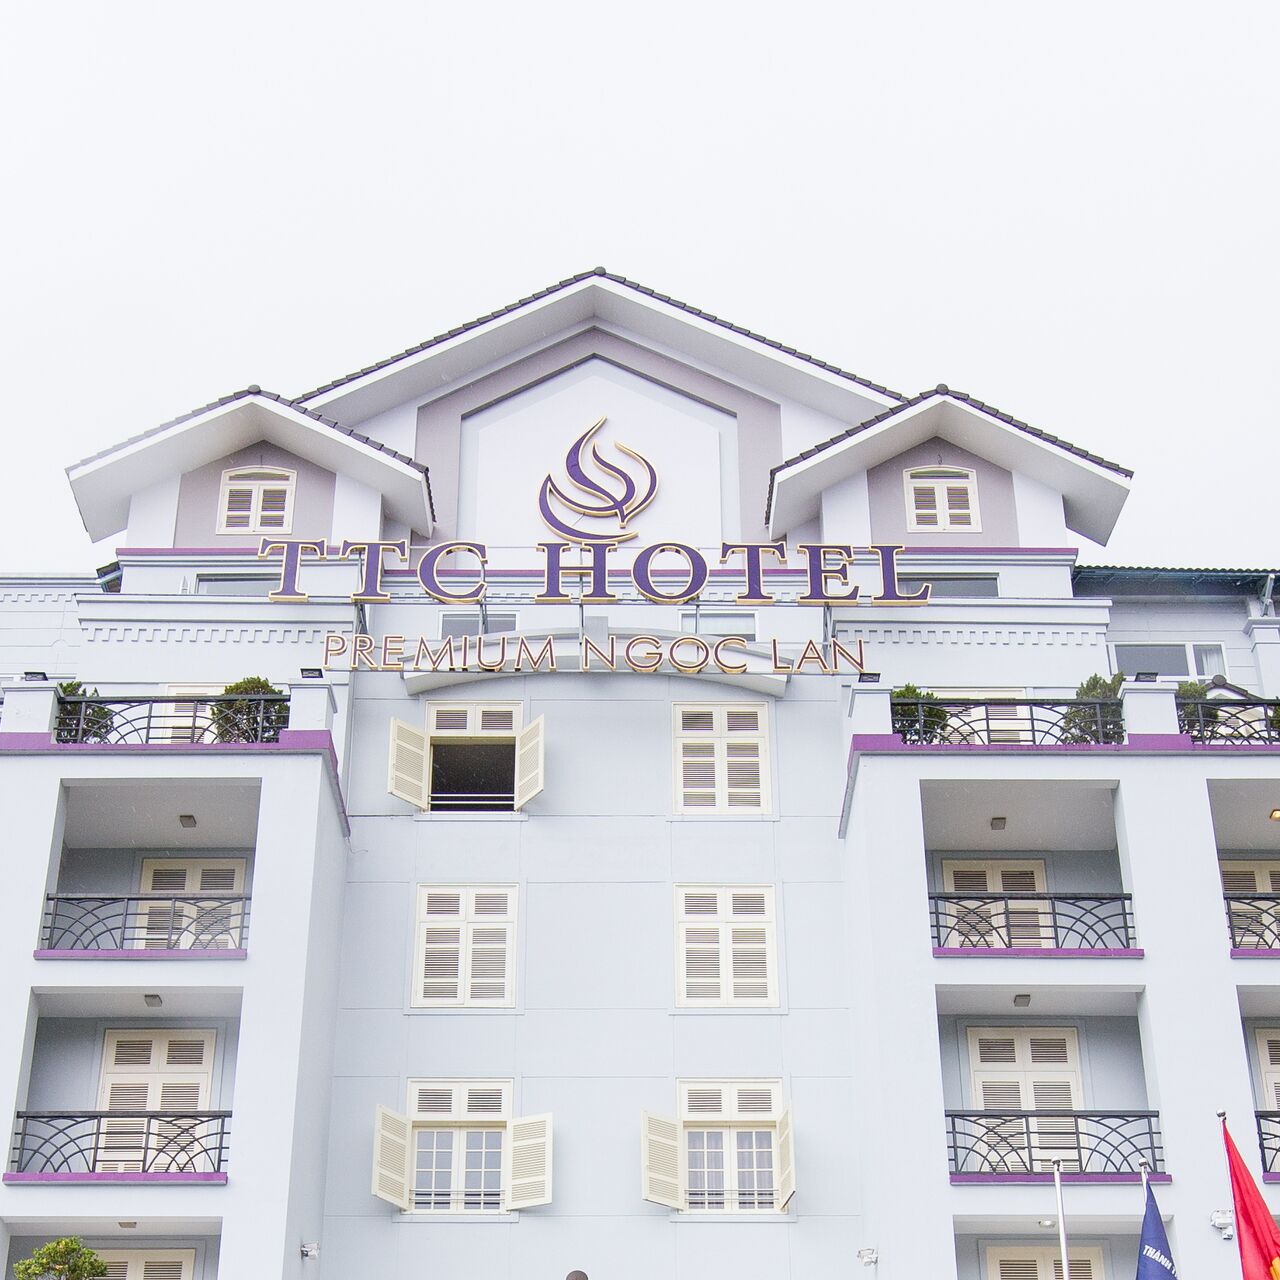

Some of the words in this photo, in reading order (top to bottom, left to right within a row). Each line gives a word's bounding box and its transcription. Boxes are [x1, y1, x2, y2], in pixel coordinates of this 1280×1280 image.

[257, 537, 488, 602] TTC
[535, 541, 932, 605] HOTEL
[322, 634, 557, 672] PREMIUM
[582, 635, 748, 673] NGOC
[770, 637, 866, 673] LAN
